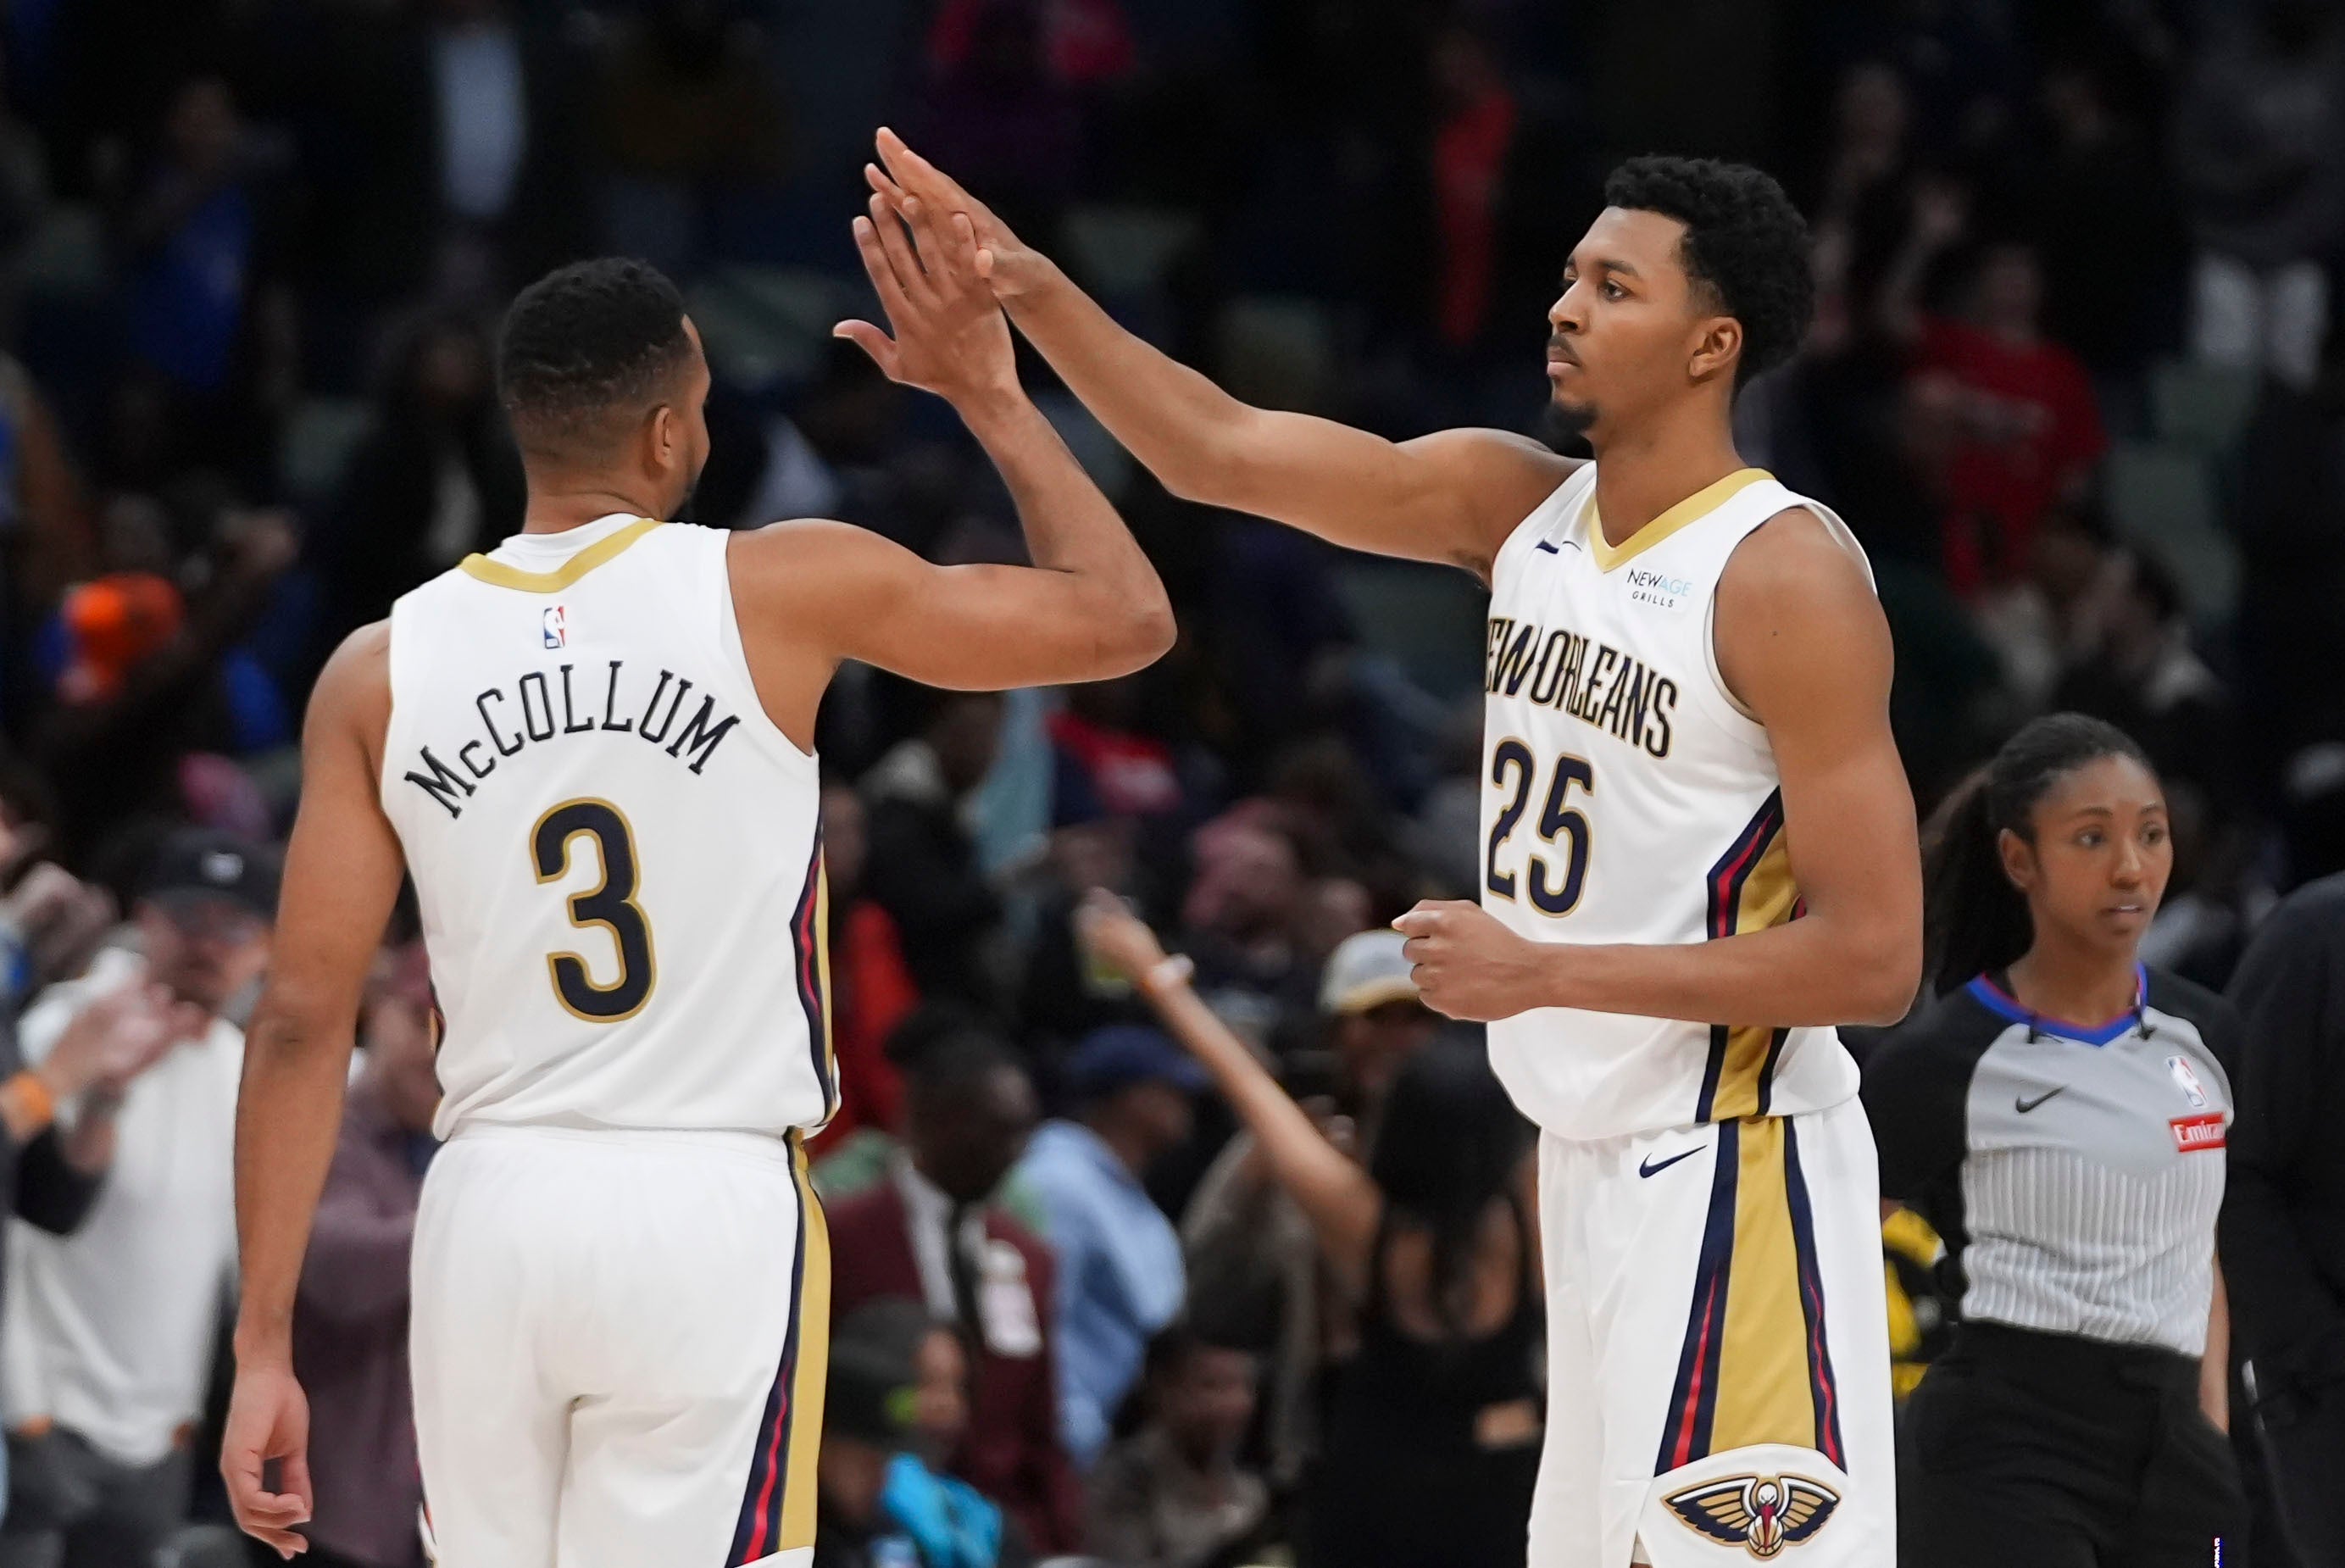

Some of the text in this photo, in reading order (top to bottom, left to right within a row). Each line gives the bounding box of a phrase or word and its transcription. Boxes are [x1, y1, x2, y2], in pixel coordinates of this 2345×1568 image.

[1632, 591, 1675, 608] GRILLS
[403, 660, 741, 820] McCOLLUM
[1530, 629, 1678, 759] ORLEANS
[1486, 735, 1595, 918] 25
[530, 796, 658, 1023] 3
